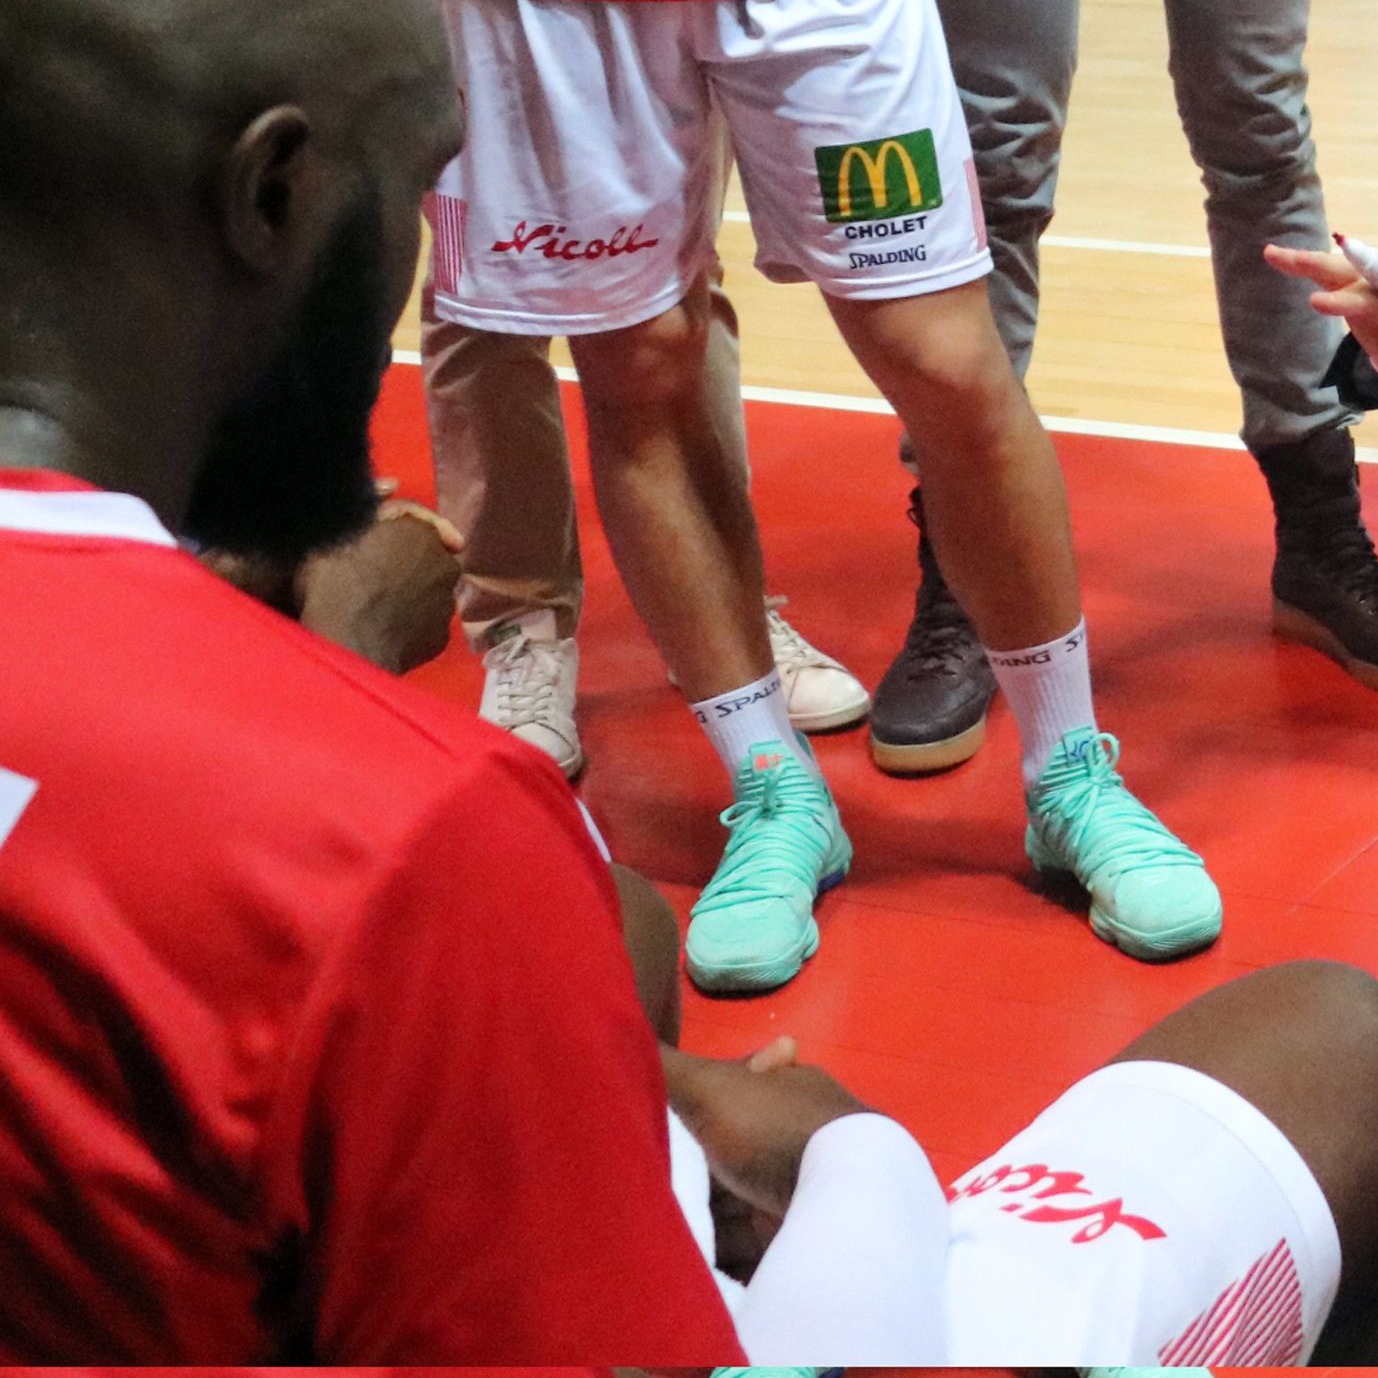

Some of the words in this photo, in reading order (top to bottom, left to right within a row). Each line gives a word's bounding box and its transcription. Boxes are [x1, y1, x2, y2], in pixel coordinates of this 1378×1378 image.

[491, 220, 659, 261] Nicoll
[844, 215, 927, 240] CHOLET
[849, 244, 927, 270] SPALDING
